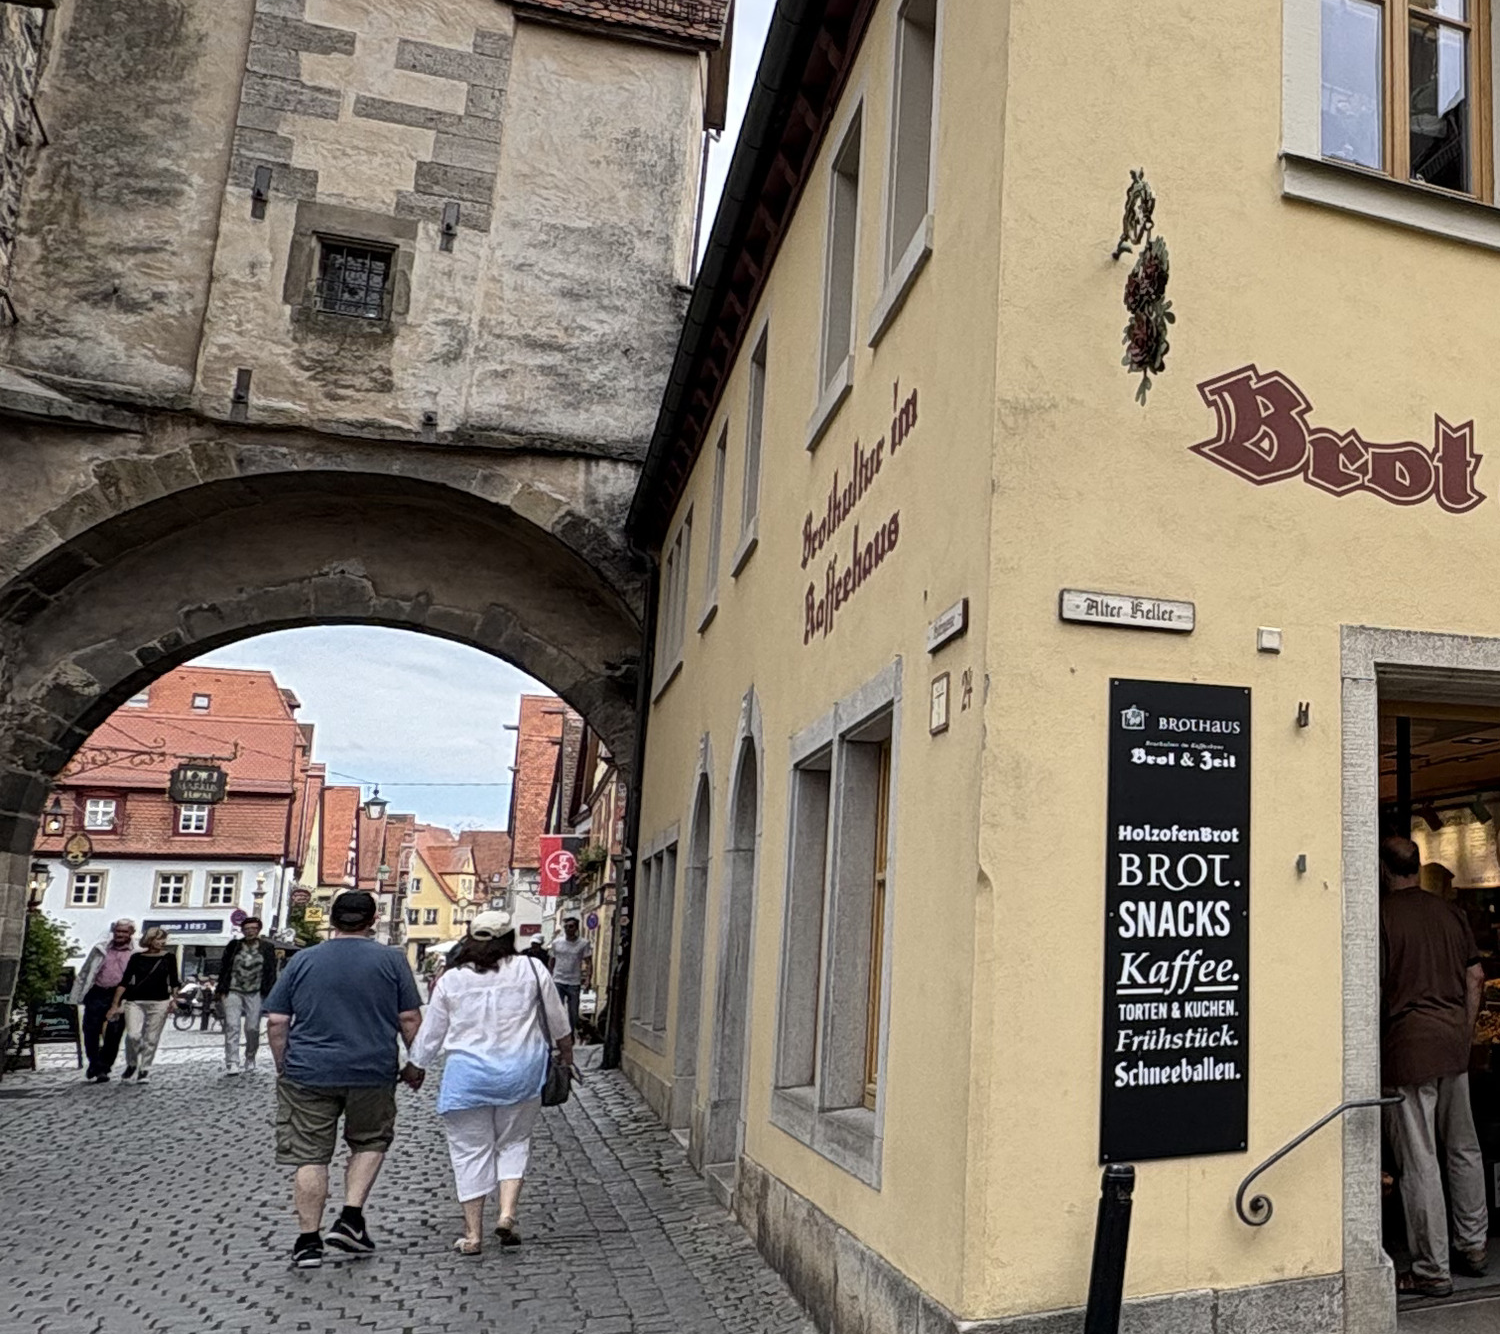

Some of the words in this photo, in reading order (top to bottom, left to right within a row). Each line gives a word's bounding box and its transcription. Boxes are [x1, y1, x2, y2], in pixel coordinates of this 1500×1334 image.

[1187, 363, 1487, 515] Brot
[801, 435, 885, 570] Brotkultur
[890, 375, 918, 456] im
[803, 508, 900, 646] Kaffeehaus
[1083, 597, 1123, 619] Alter
[1129, 598, 1175, 623] Keller
[1130, 747, 1175, 765] Brot
[1180, 751, 1195, 767] &
[1199, 750, 1236, 771] Zeit
[1117, 824, 1240, 844] HolzofenBrot
[1117, 853, 1241, 892] BROT.
[1118, 900, 1231, 938] SNACKS
[1117, 949, 1240, 995] Kaffee.
[1118, 1002, 1168, 1021] TORTEN
[1171, 1001, 1182, 1018] &
[1184, 999, 1239, 1018] KUCHEN.
[1115, 1024, 1239, 1052] Frühstück.
[1114, 1056, 1242, 1087] Schneeballen.
